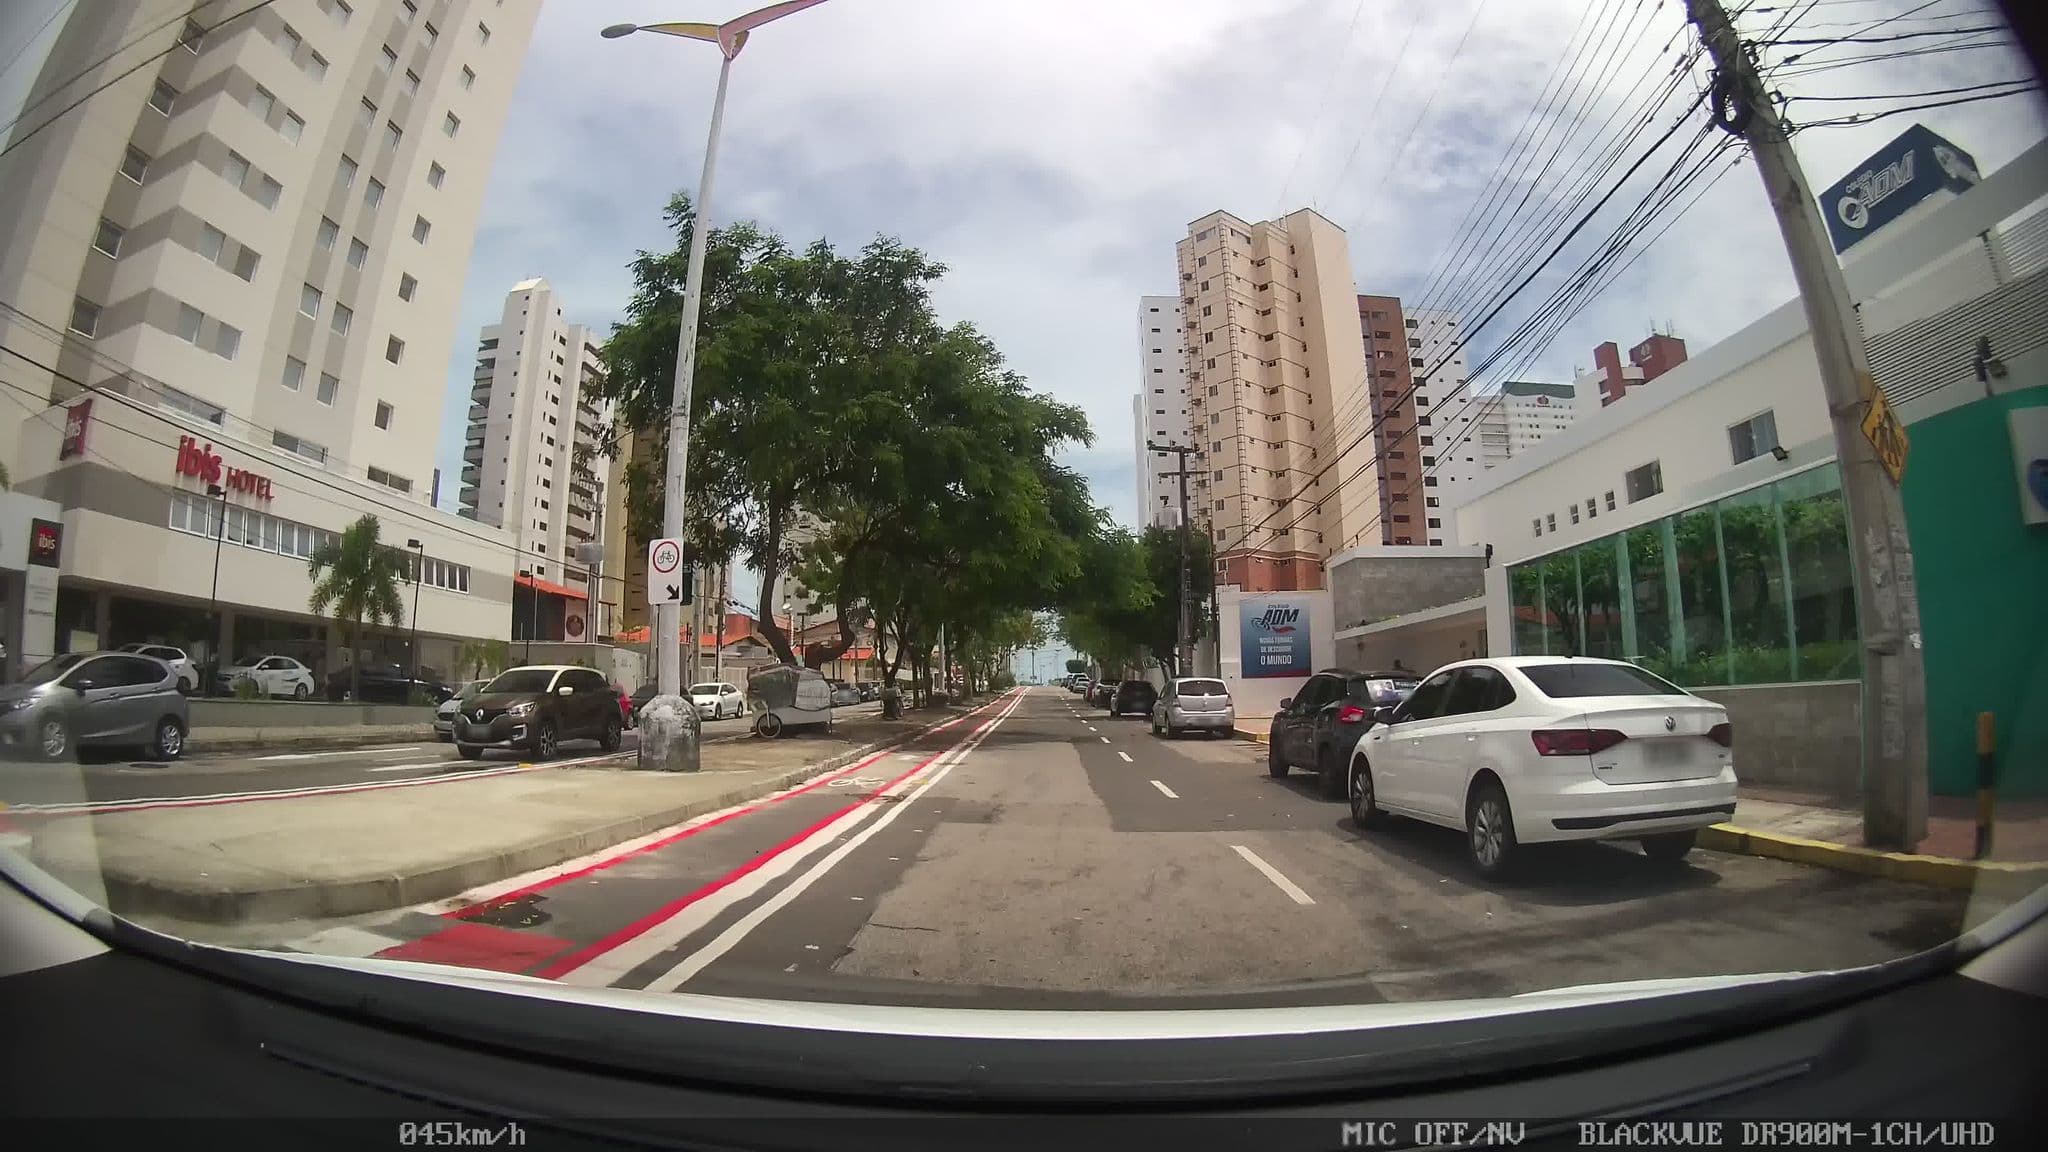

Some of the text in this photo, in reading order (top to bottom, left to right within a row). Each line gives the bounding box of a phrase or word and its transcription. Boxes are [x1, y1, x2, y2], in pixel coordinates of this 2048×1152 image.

[1858, 149, 1915, 207] ADM
[176, 435, 275, 500] ibis HOTEL
[38, 533, 56, 550] ibis
[1260, 608, 1300, 626] ADM
[1260, 655, 1292, 666] O MUNDO
